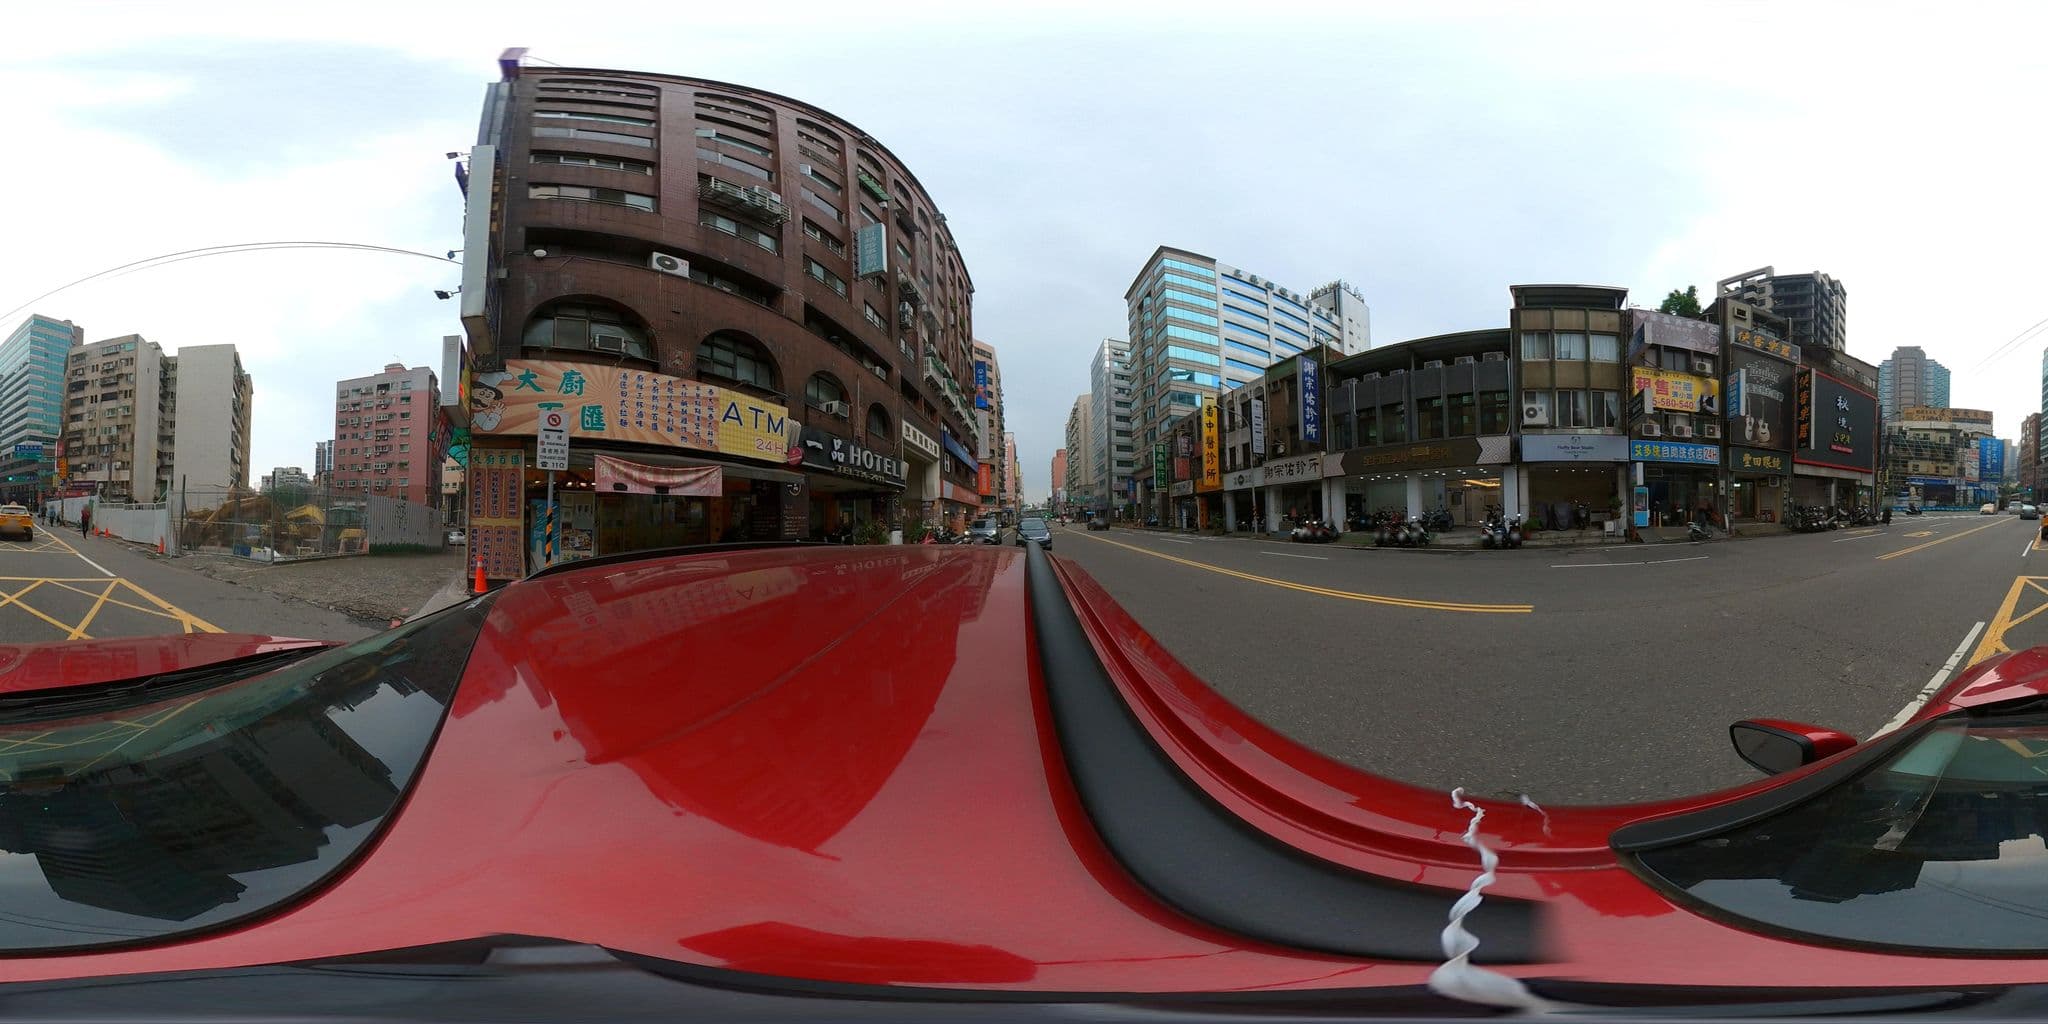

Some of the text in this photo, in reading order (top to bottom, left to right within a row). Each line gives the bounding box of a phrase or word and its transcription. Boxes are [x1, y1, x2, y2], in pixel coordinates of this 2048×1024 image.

[514, 368, 586, 396] 大廚
[1304, 360, 1318, 439] 謝宗佑診所
[537, 402, 606, 431] 匯
[722, 402, 784, 437] ATM
[755, 438, 785, 455] 24H
[1204, 396, 1217, 482] 一番中醫診所
[806, 438, 901, 477] 一品 HOTEL
[1264, 457, 1320, 479] 謝宗佑診所
